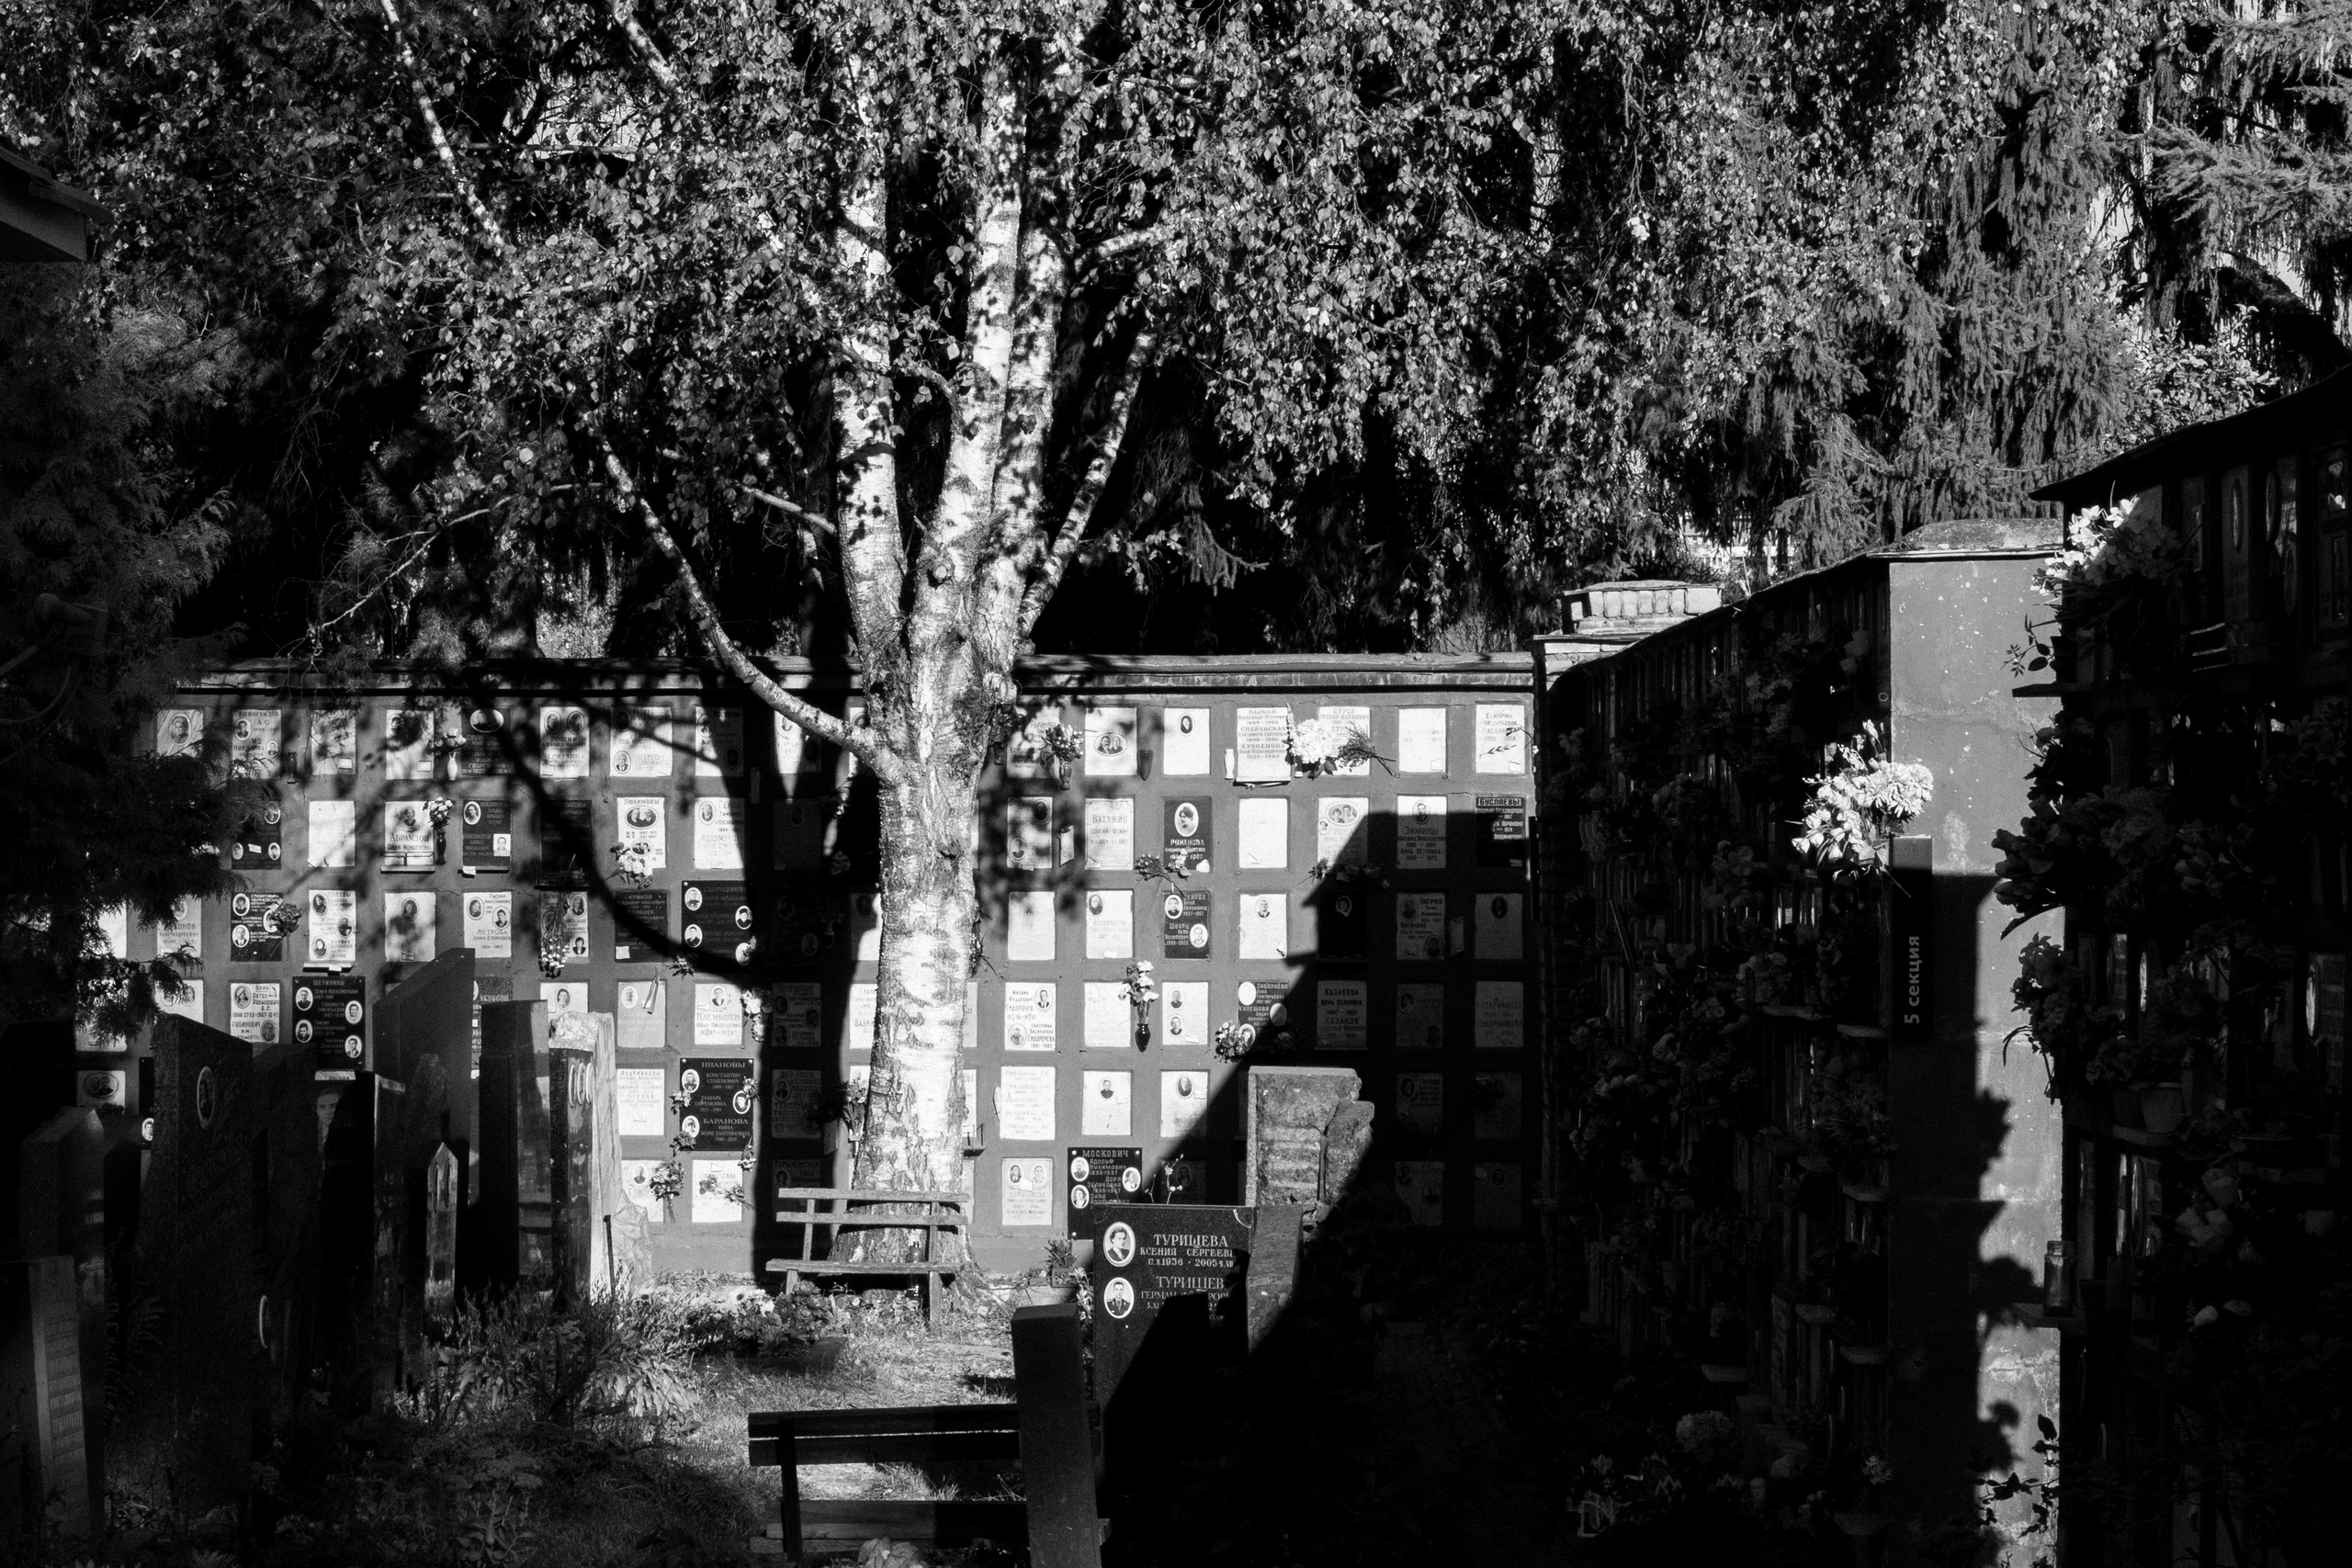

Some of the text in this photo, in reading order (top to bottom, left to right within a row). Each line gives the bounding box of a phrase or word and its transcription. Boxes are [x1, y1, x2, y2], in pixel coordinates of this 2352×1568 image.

[1905, 935, 1923, 1024] 5 секция
[1153, 1234, 1228, 1248] ТУРИЩЕВА
[1140, 1247, 1233, 1258] КСЕНИЯ СЕРГЕЕВ
[1156, 1275, 1225, 1292] ТУРИЩЕВ
